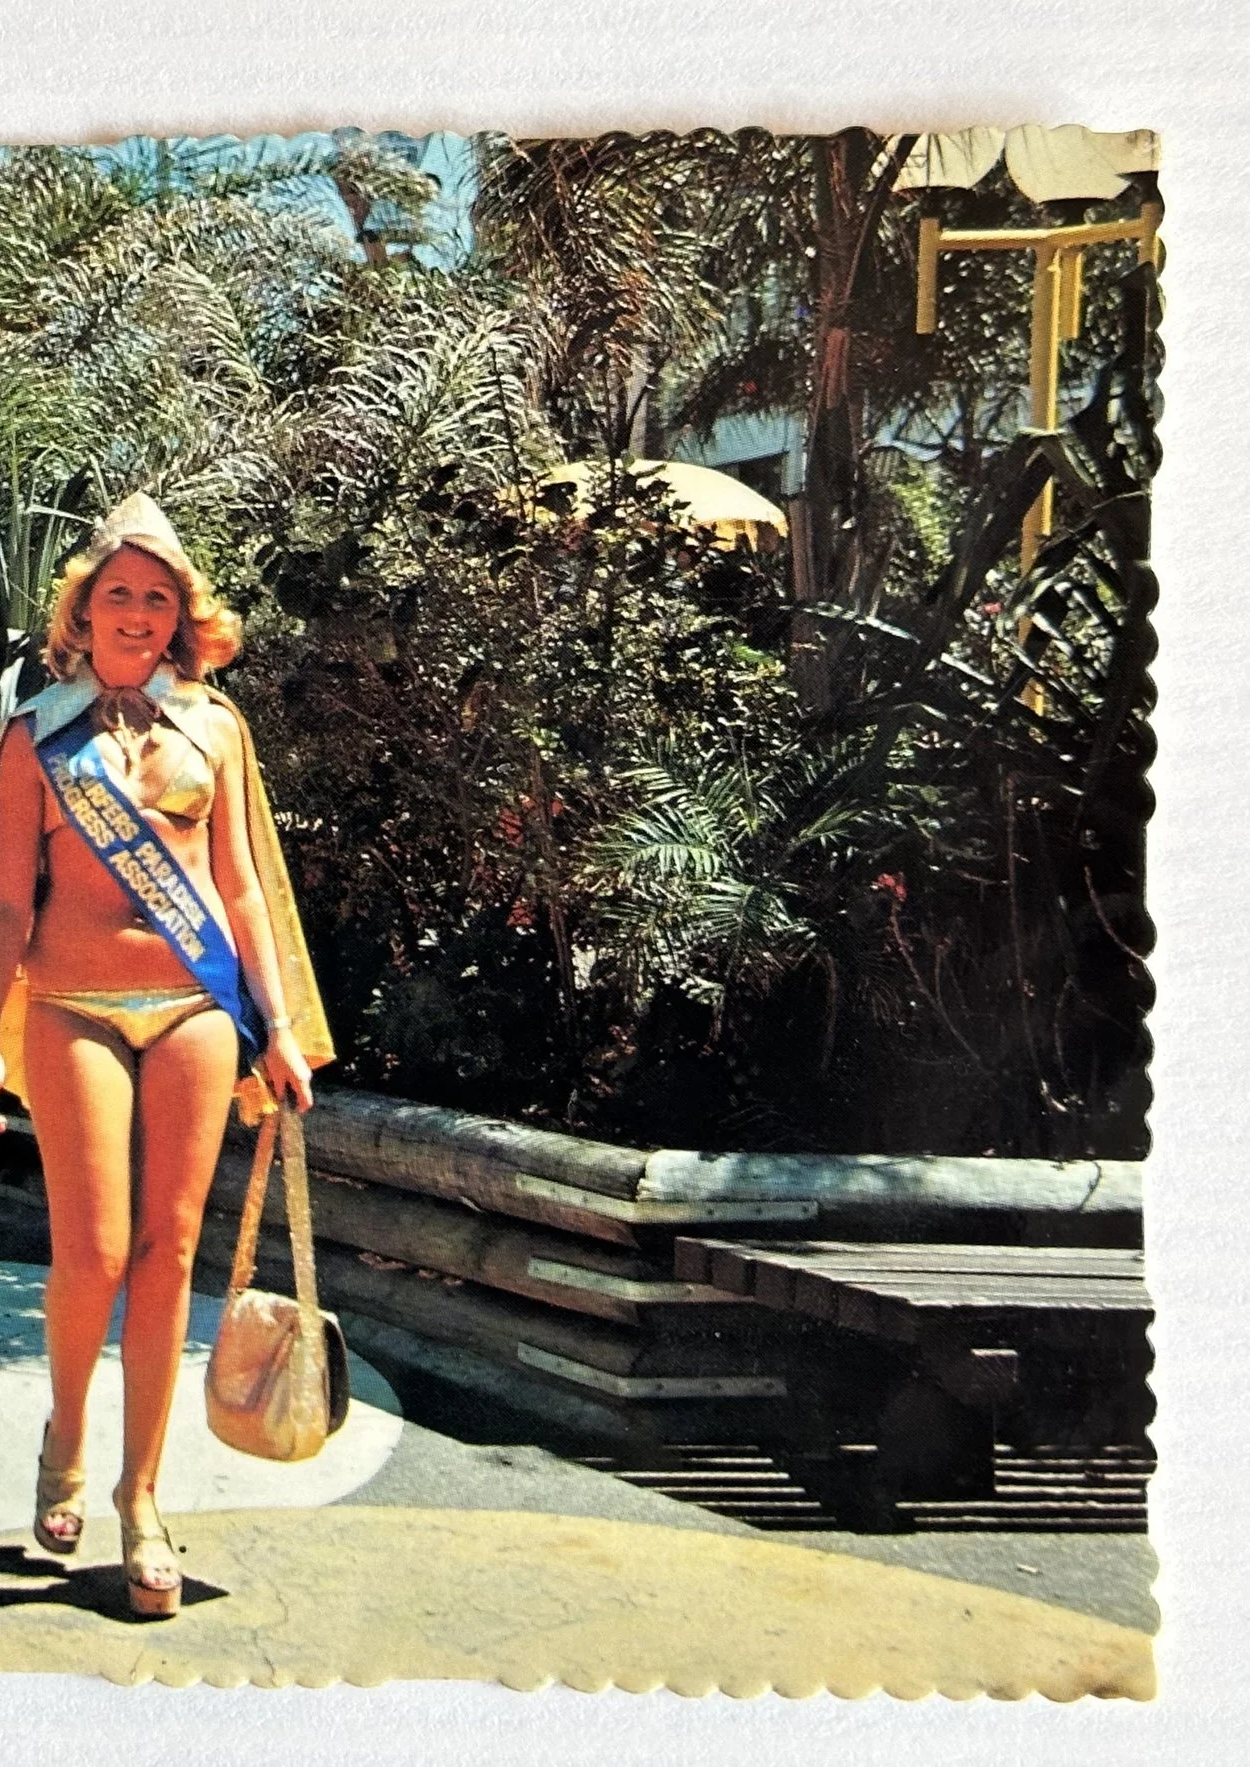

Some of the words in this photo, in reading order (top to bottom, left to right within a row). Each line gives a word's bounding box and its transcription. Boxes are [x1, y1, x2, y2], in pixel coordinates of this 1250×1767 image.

[74, 768, 139, 842] URFERS
[134, 841, 206, 931] PARADISE
[109, 850, 206, 962] ASSOCIATION
